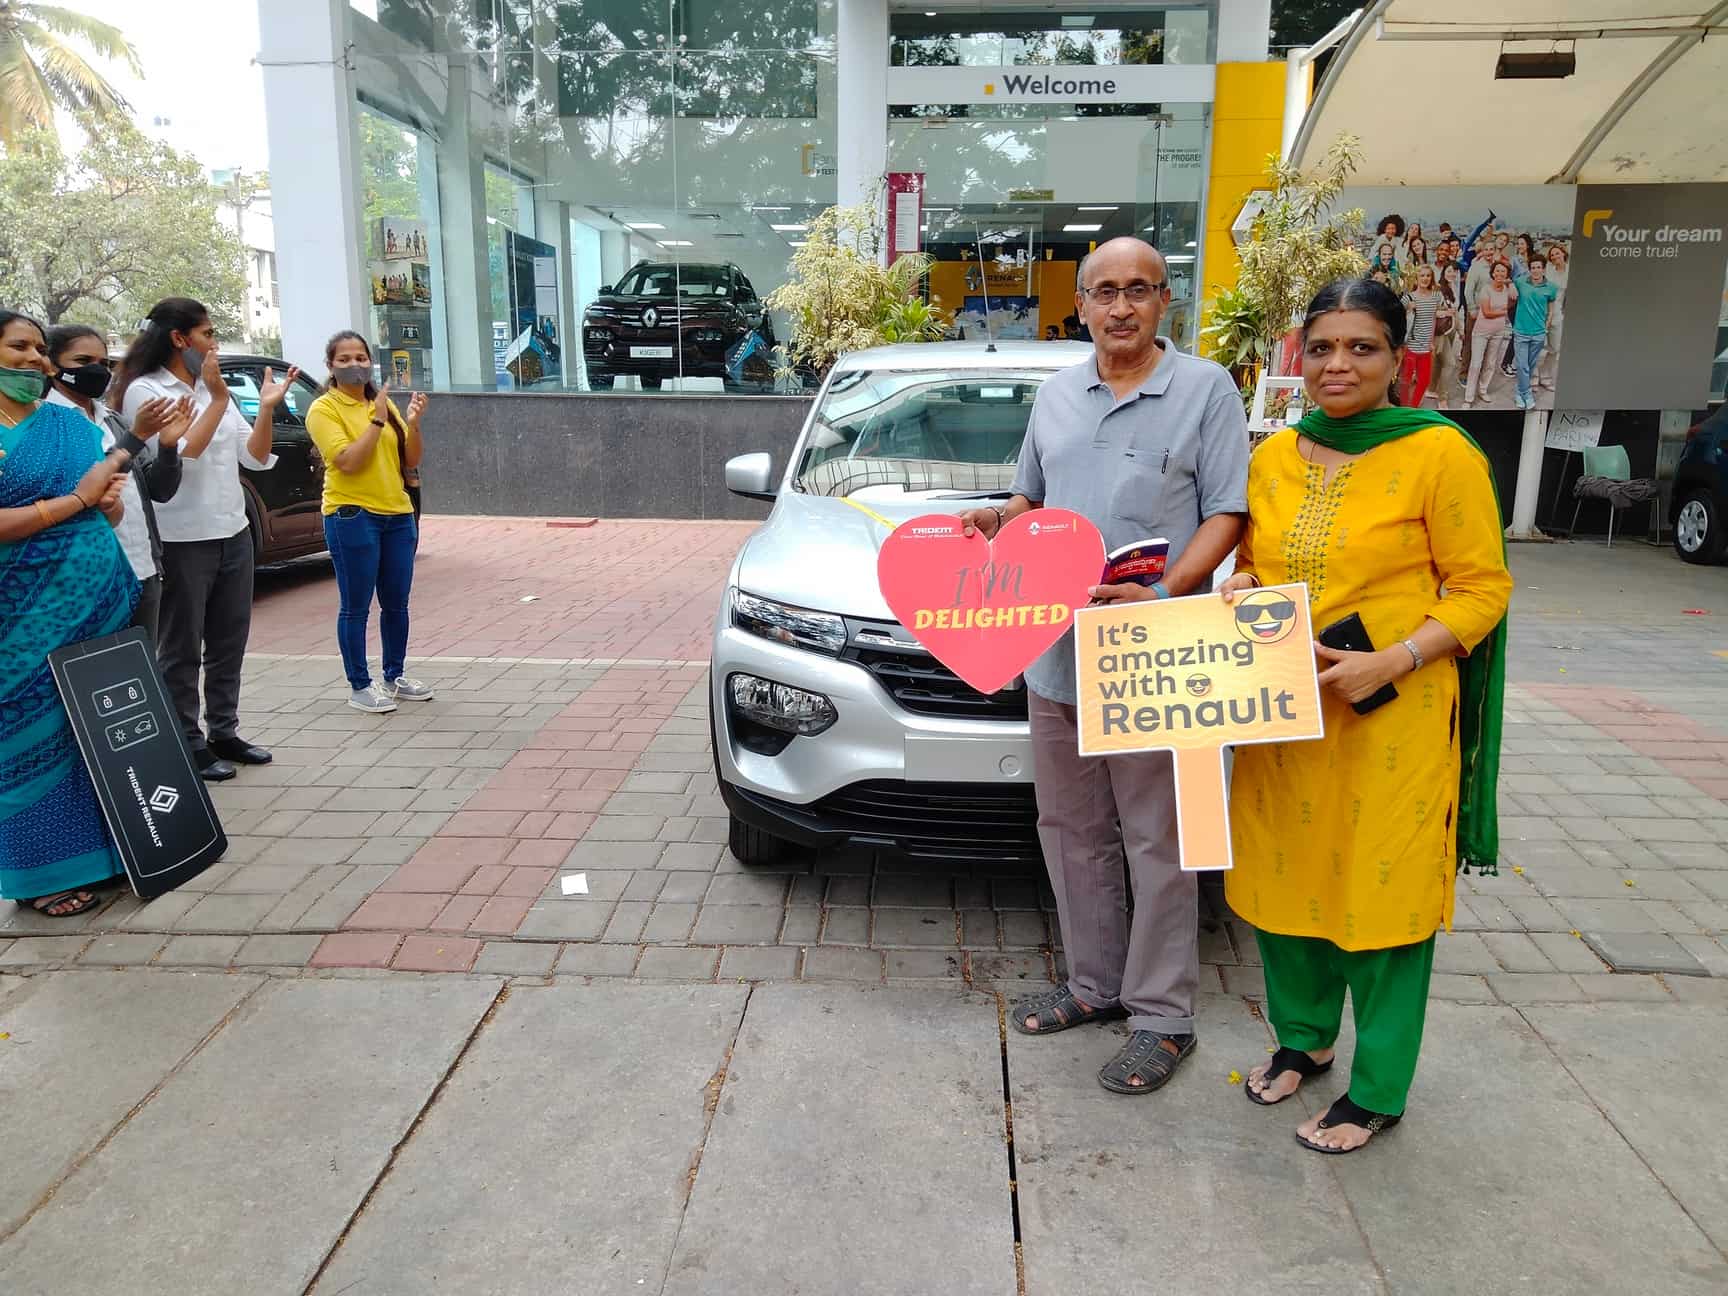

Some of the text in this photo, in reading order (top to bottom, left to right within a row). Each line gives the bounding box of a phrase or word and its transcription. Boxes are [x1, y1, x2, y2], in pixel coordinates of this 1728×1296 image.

[1002, 74, 1117, 95] Welcome
[1602, 224, 1722, 242] Your dream
[1600, 244, 1679, 258] come true!
[911, 527, 954, 535] TRIDENT
[914, 603, 1069, 630] DELIGHTED
[1097, 622, 1149, 648] It's
[1097, 639, 1255, 673] amazing
[1098, 670, 1177, 700] with
[1102, 687, 1297, 736] Renault
[126, 765, 163, 848] TRIDENT RENAULT
